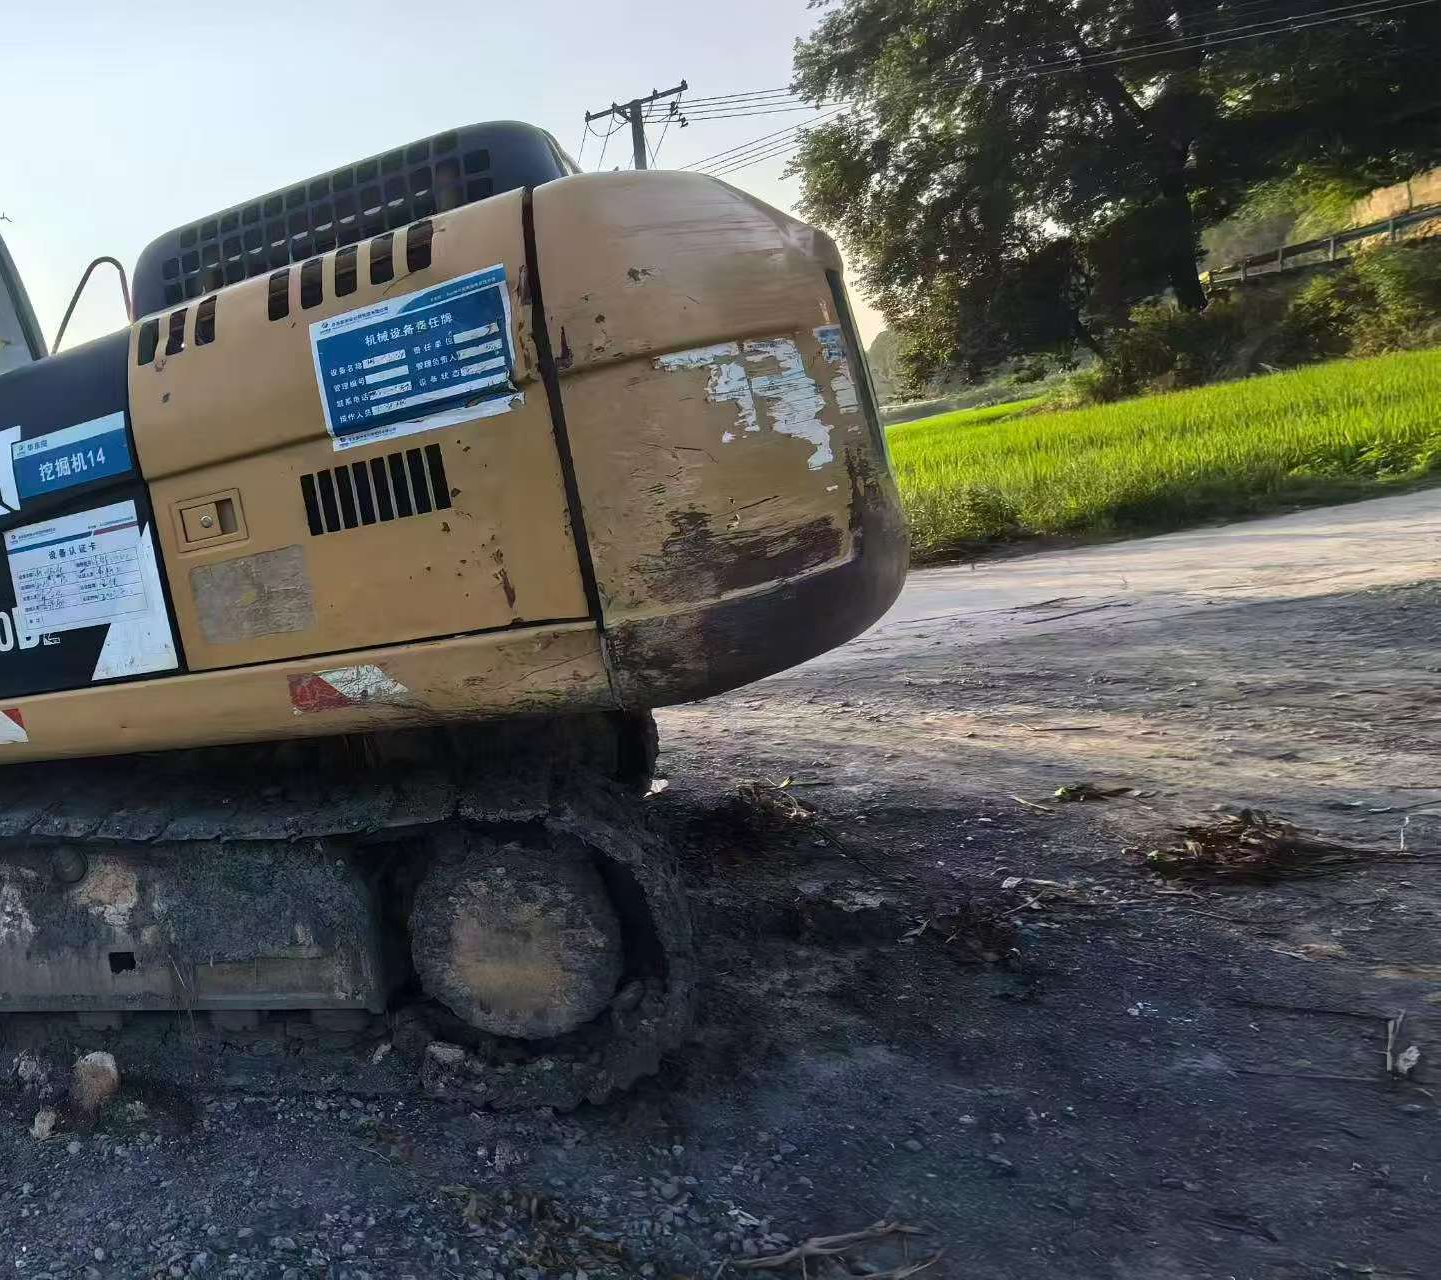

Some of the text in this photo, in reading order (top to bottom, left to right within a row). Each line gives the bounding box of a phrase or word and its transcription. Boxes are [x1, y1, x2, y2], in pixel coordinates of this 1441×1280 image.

[39, 447, 106, 482] 挖掘机14
[48, 541, 97, 560] 设备认证卡
